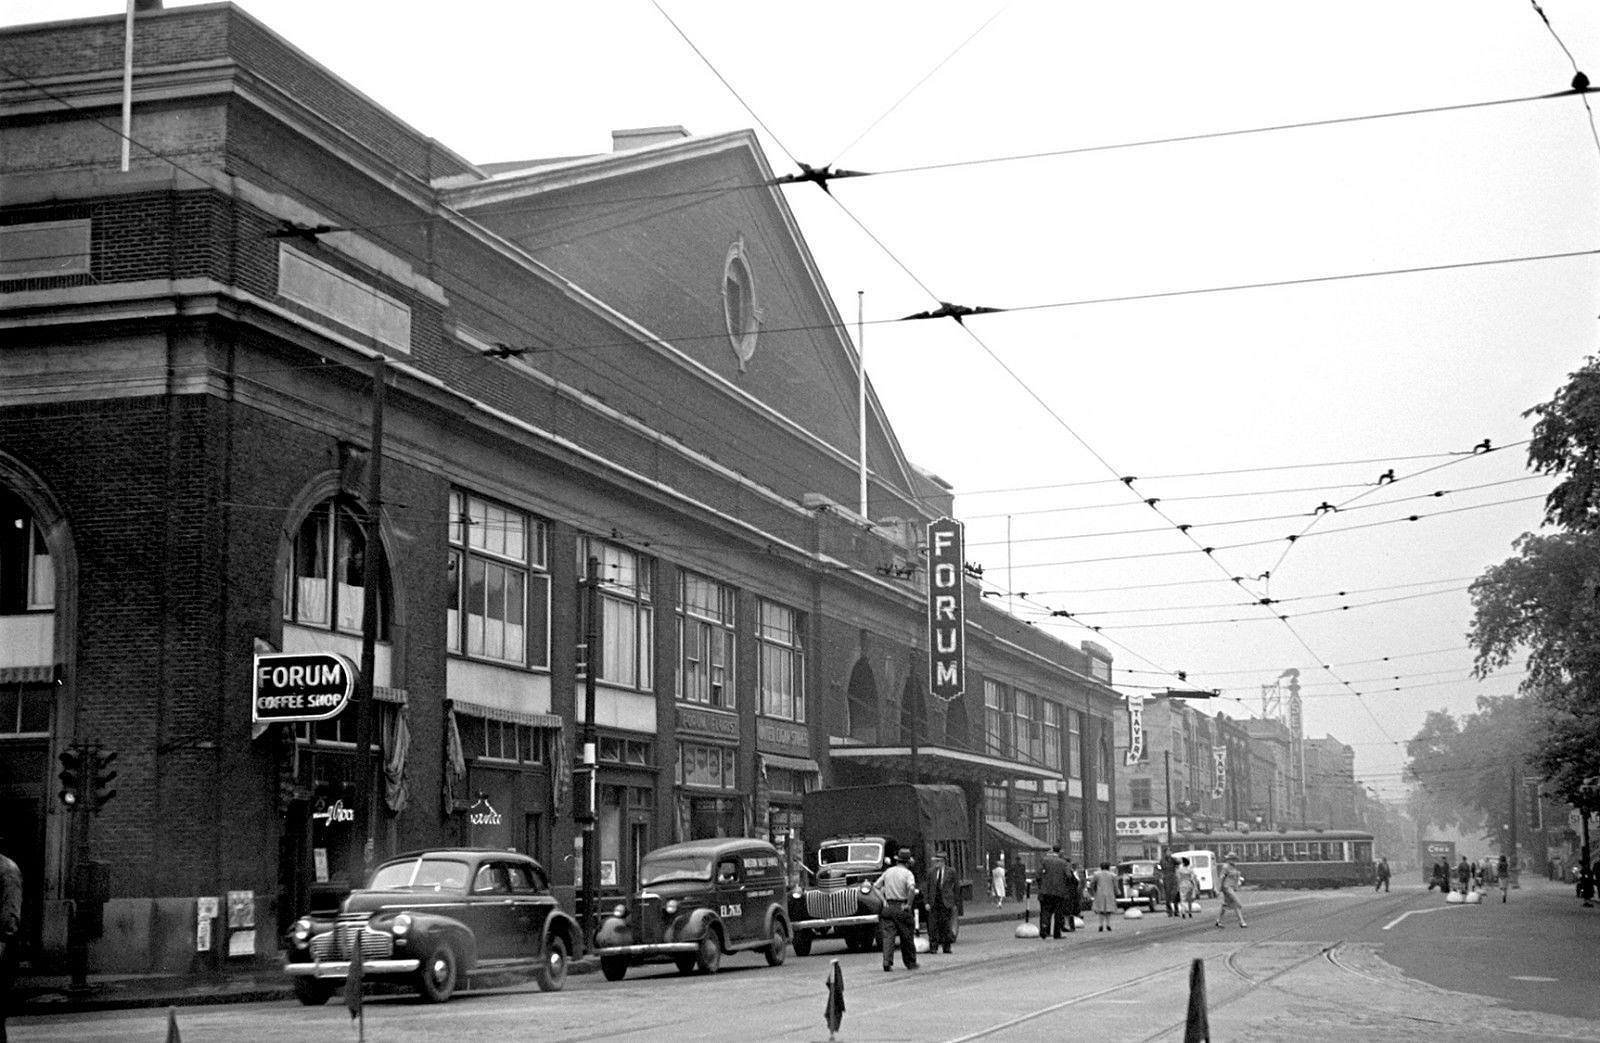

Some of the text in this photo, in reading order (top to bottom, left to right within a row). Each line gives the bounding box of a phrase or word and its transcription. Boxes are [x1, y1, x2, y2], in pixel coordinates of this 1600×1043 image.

[934, 531, 958, 686] FORUM
[258, 664, 341, 688] FORUM
[257, 693, 342, 709] COFFEE SHOP
[1129, 709, 1140, 762] TAVERN
[1214, 753, 1224, 796] TAVERN
